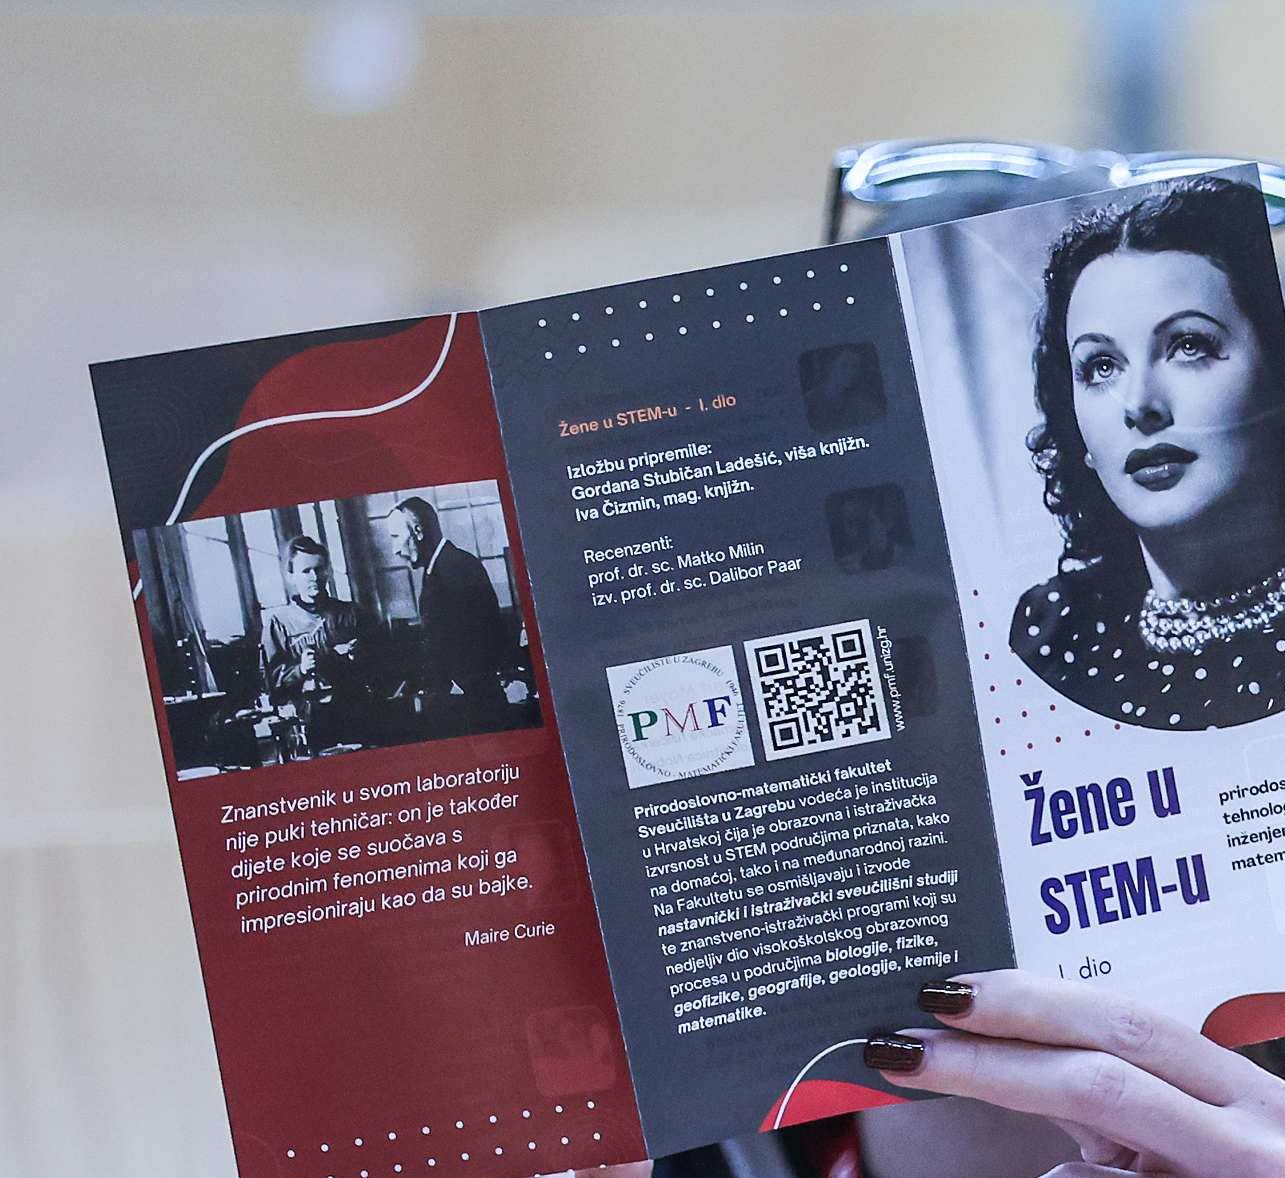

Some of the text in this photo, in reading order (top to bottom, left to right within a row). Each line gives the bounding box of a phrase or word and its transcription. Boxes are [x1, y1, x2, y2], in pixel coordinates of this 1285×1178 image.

[559, 421, 598, 437] Žene
[603, 418, 613, 428] u
[617, 406, 677, 426] STEM-u
[699, 398, 708, 411] I.
[712, 395, 736, 409] dio
[567, 443, 712, 479] Izložbu pripremile:
[572, 437, 869, 500] Gordana Stubičan Ladešić, viša knjižn.
[575, 480, 755, 522] Iva Čizmin, mag. knjižn.
[584, 536, 673, 564] Recenzenti:
[588, 542, 764, 588] prof. dr. sc. Matko Milin
[592, 559, 801, 606] izv. prof. dr. sc. Dalibor Paar
[682, 656, 725, 678] ZAGREBU
[876, 625, 906, 732] www.pmf.unizg.hr
[627, 696, 732, 742] PMF
[617, 723, 671, 778] PRIRODOSLOVNO
[221, 764, 519, 823] Znanstvenik u svom laboratoriju
[634, 759, 892, 819] Prirodoslovno-matematički fakultet
[638, 773, 938, 838] Sveučilišta u Zagrebu vodeća je institucija
[1019, 766, 1182, 847] Žene u
[227, 793, 519, 853] nije puki tehničar: on je također
[642, 794, 936, 858] u Hrvatskoj čija je obrazovna i istraživačka
[645, 813, 950, 877] izvrsnost u STEM područjima priznata, kako
[231, 830, 462, 880] dijete koje se suočava s
[237, 849, 517, 910] prirodnim fenomenima koji ga
[650, 831, 948, 897] na domaćoj, tako i na međunarodnoj razini.
[241, 875, 533, 933] impresioniraju kao da su bajke.
[653, 857, 910, 917] Na Fakultetu se osmišljavaju i izvode
[658, 870, 958, 936] nastavnički i istraživački sveučilišni studiji
[1040, 853, 1211, 935] STEM-u
[465, 921, 555, 946] Maire Curie
[662, 892, 956, 956] te znanstveno-istraživački programi koji su
[666, 914, 948, 975] nedjeljiv dio visokoškolskog obrazovnog
[670, 934, 938, 998] procesa u područjima biologije, fizike,
[674, 950, 958, 1017] geofizike, geografije, geologije, kemije i
[1079, 956, 1112, 979] dio
[678, 1006, 766, 1034] matematike.
